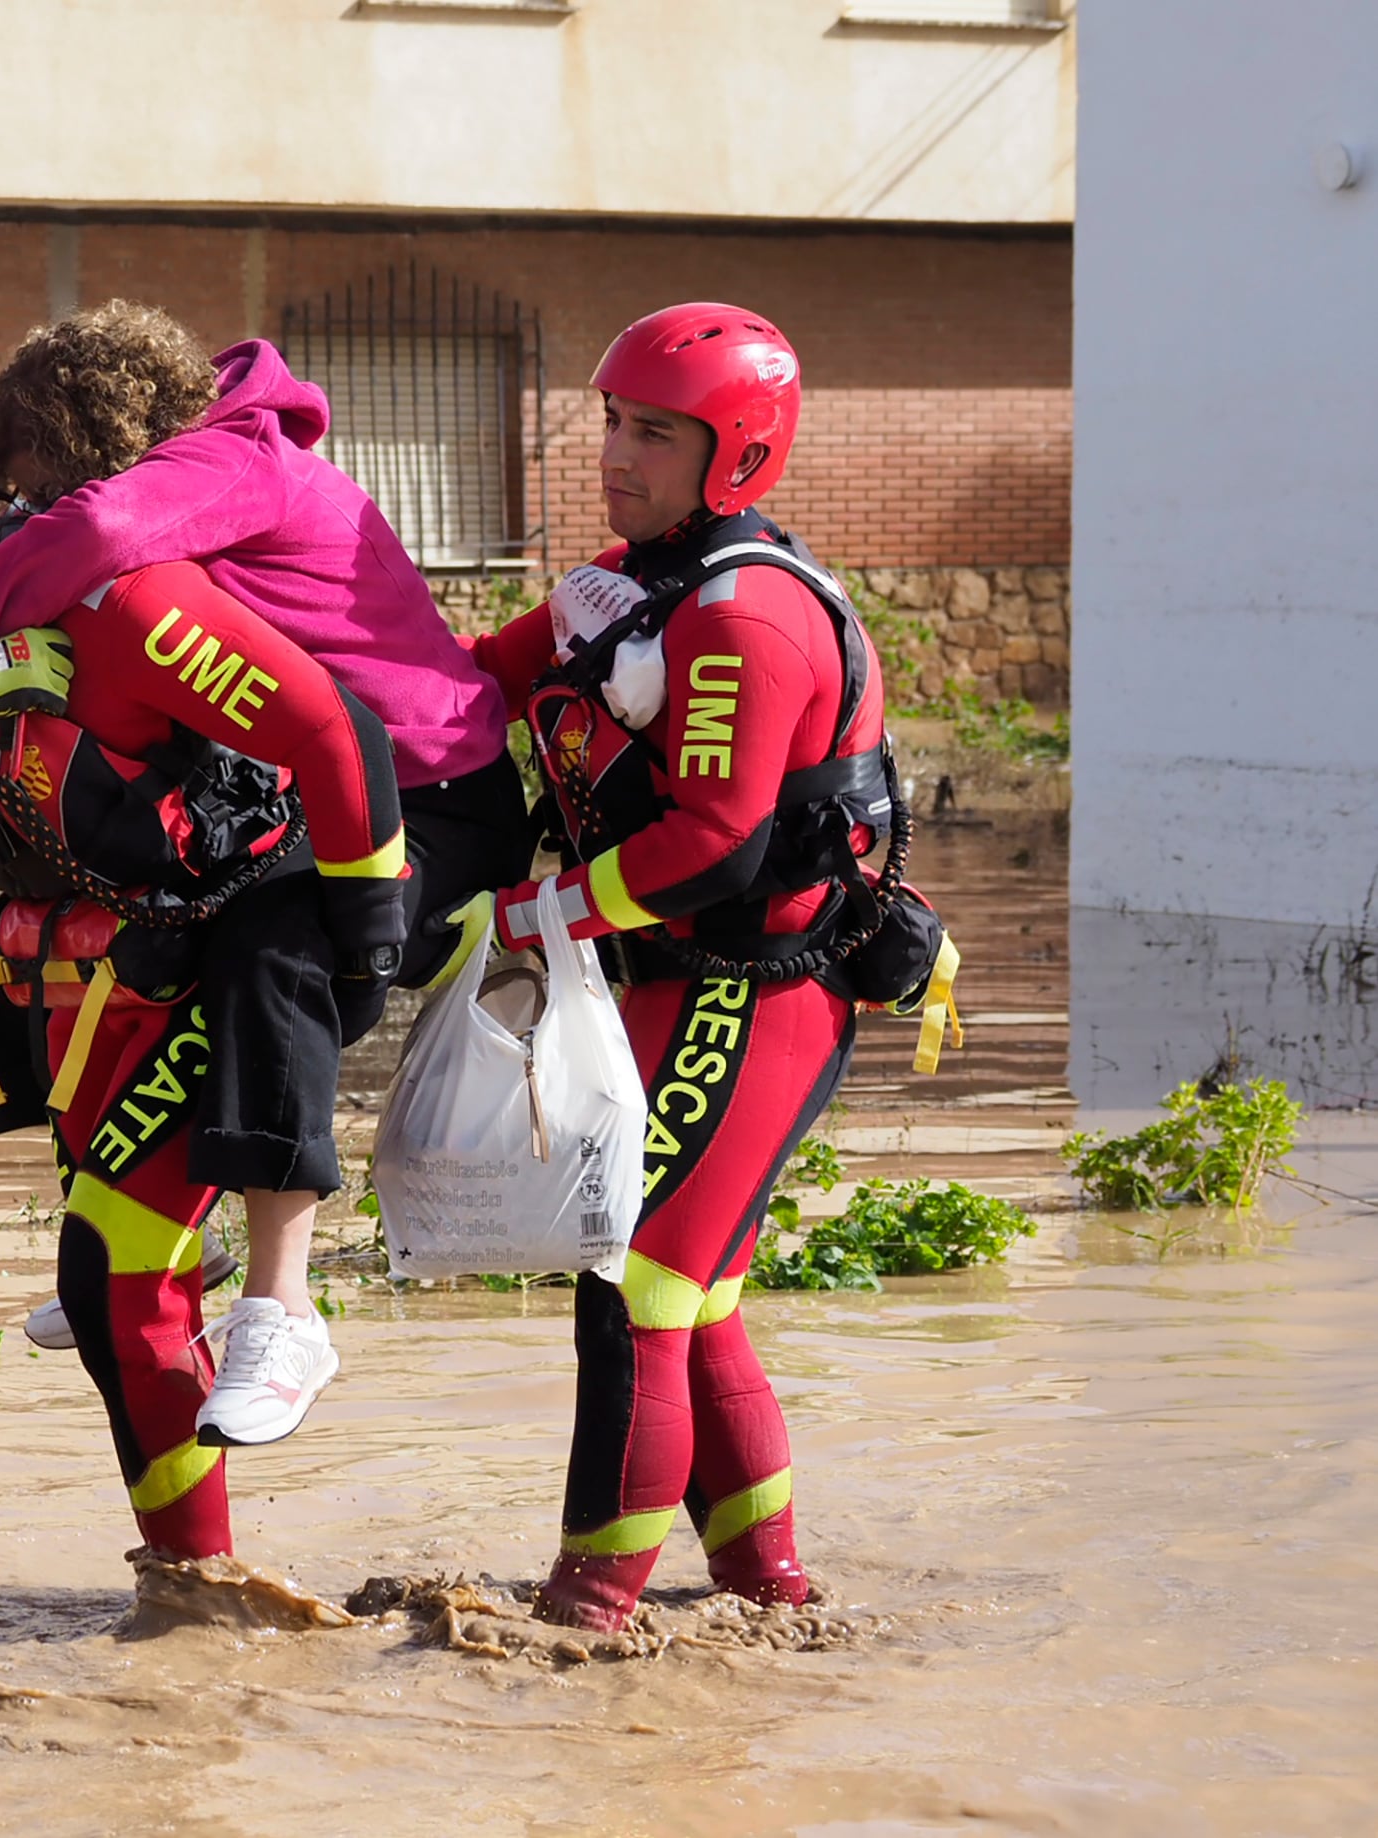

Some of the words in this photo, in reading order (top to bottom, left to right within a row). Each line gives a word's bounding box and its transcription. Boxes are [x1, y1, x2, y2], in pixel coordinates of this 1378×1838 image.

[144, 606, 280, 732] UME
[679, 655, 743, 779] UME
[405, 1156, 519, 1179] reutilizable
